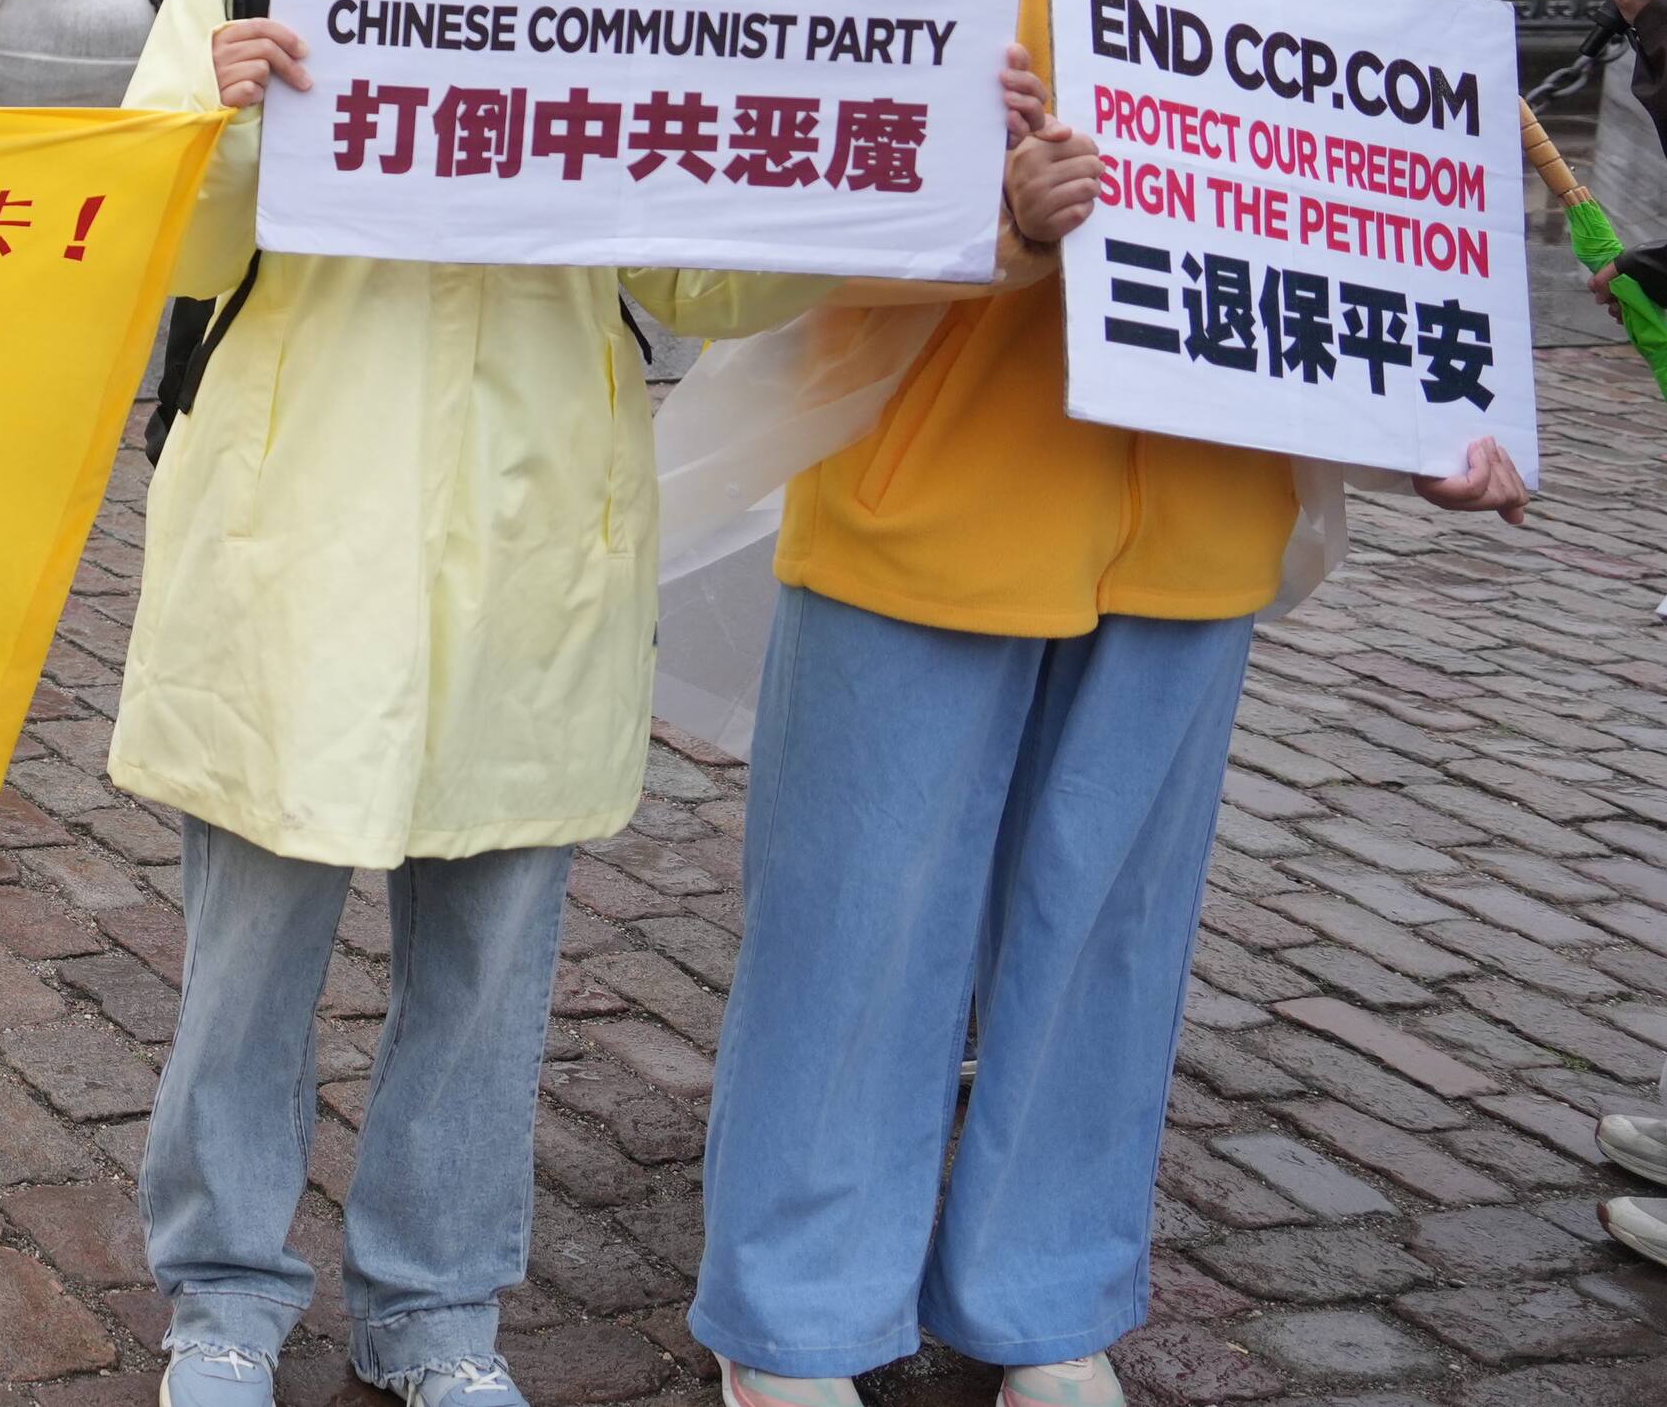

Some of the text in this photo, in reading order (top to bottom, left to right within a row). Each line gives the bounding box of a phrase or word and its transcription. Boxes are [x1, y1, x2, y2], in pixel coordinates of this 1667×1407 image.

[528, 6, 799, 61] COMMUNIST
[805, 16, 958, 67] PARTY
[1223, 22, 1481, 138] CCP.COM
[332, 78, 928, 194] 打倒中共恶魔
[1093, 83, 1486, 213] PROTECT OUR FREEDOM
[1097, 154, 1490, 279] SIGN THE PETITION
[1103, 236, 1496, 414] 三退保平安
